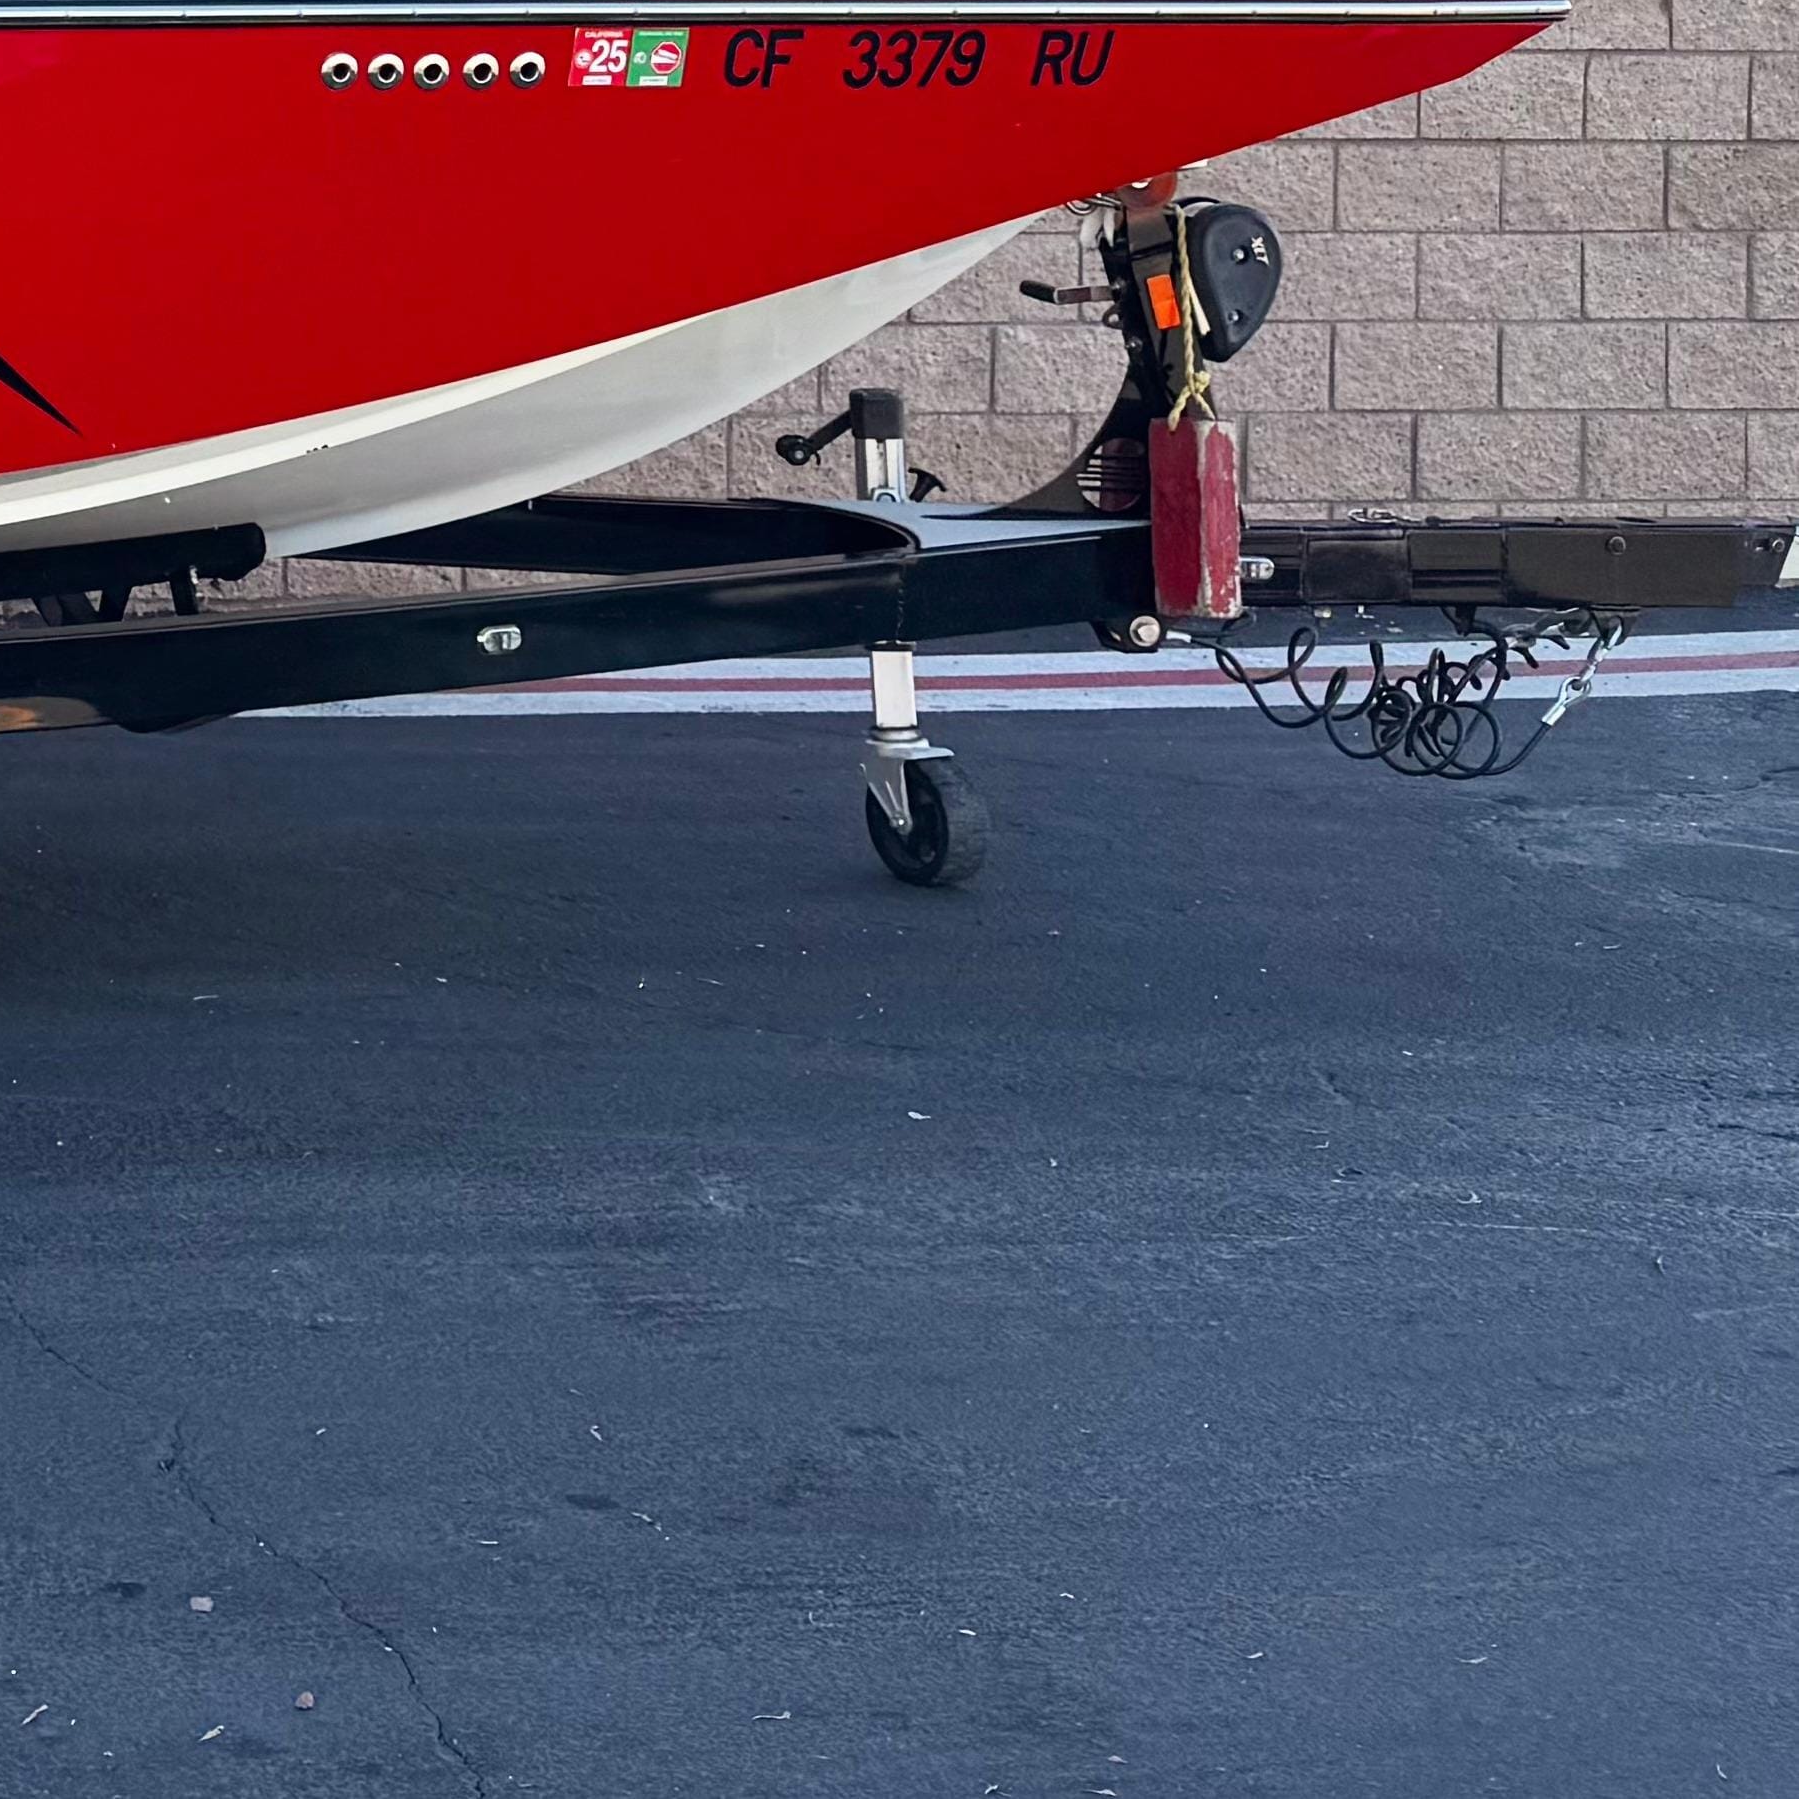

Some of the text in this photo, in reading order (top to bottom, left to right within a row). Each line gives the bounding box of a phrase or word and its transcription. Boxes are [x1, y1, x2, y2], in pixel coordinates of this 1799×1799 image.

[588, 39, 629, 73] 25
[724, 29, 1115, 89] CF 3379 RU
